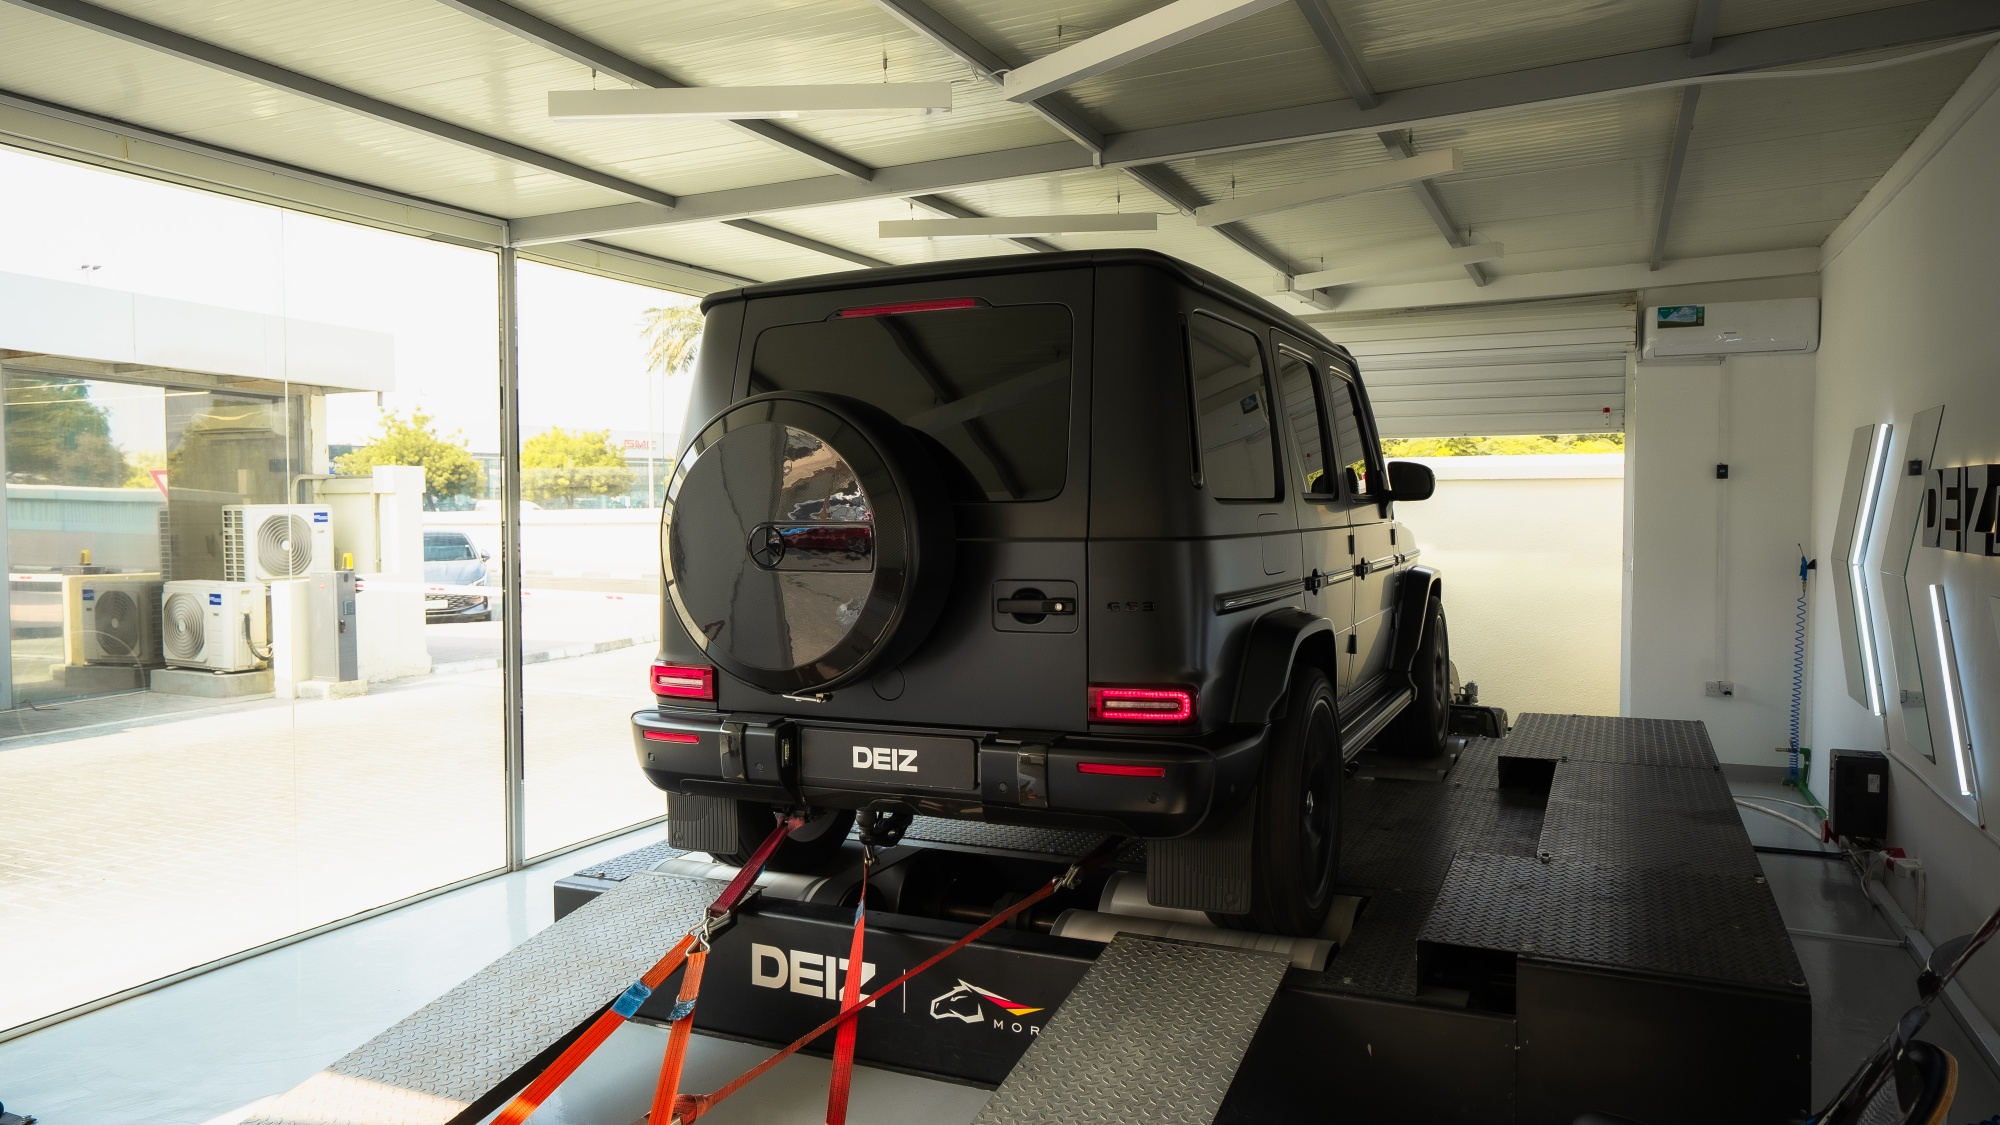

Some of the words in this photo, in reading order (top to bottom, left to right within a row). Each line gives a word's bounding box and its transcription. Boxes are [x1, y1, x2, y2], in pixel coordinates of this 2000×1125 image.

[1922, 464, 1988, 556] DEIZ
[852, 745, 919, 773] DEIZ
[751, 942, 876, 1008] DEIZ
